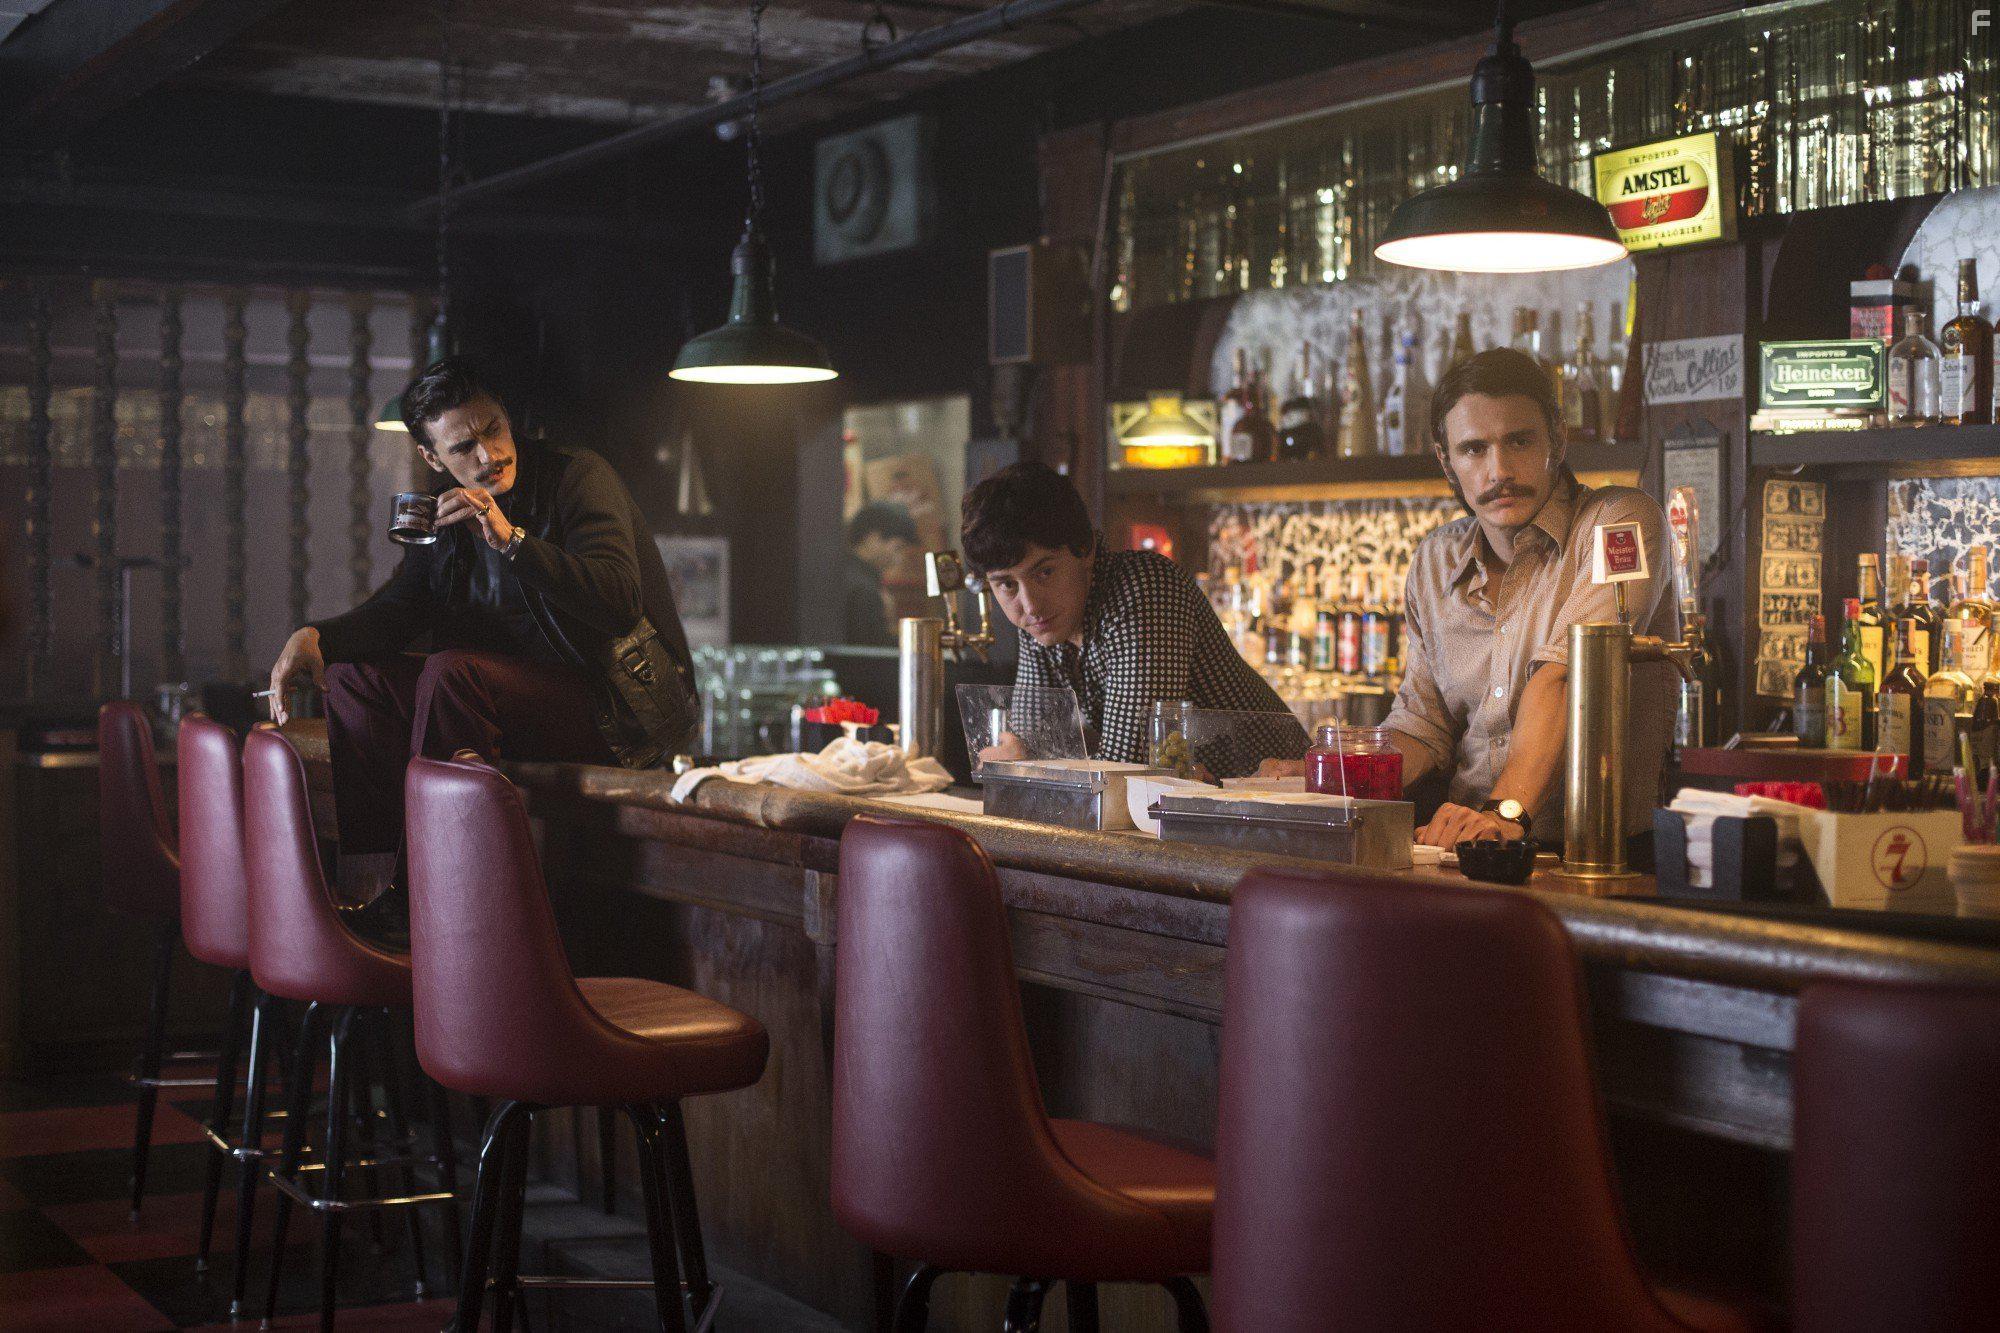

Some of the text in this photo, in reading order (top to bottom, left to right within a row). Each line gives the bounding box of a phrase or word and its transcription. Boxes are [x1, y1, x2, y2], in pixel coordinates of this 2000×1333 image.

[1622, 165, 1691, 195] AMSTEL
[1777, 363, 1867, 383] Heineken
[1607, 546, 1635, 556] Meister
[1885, 843, 1912, 883] 7
